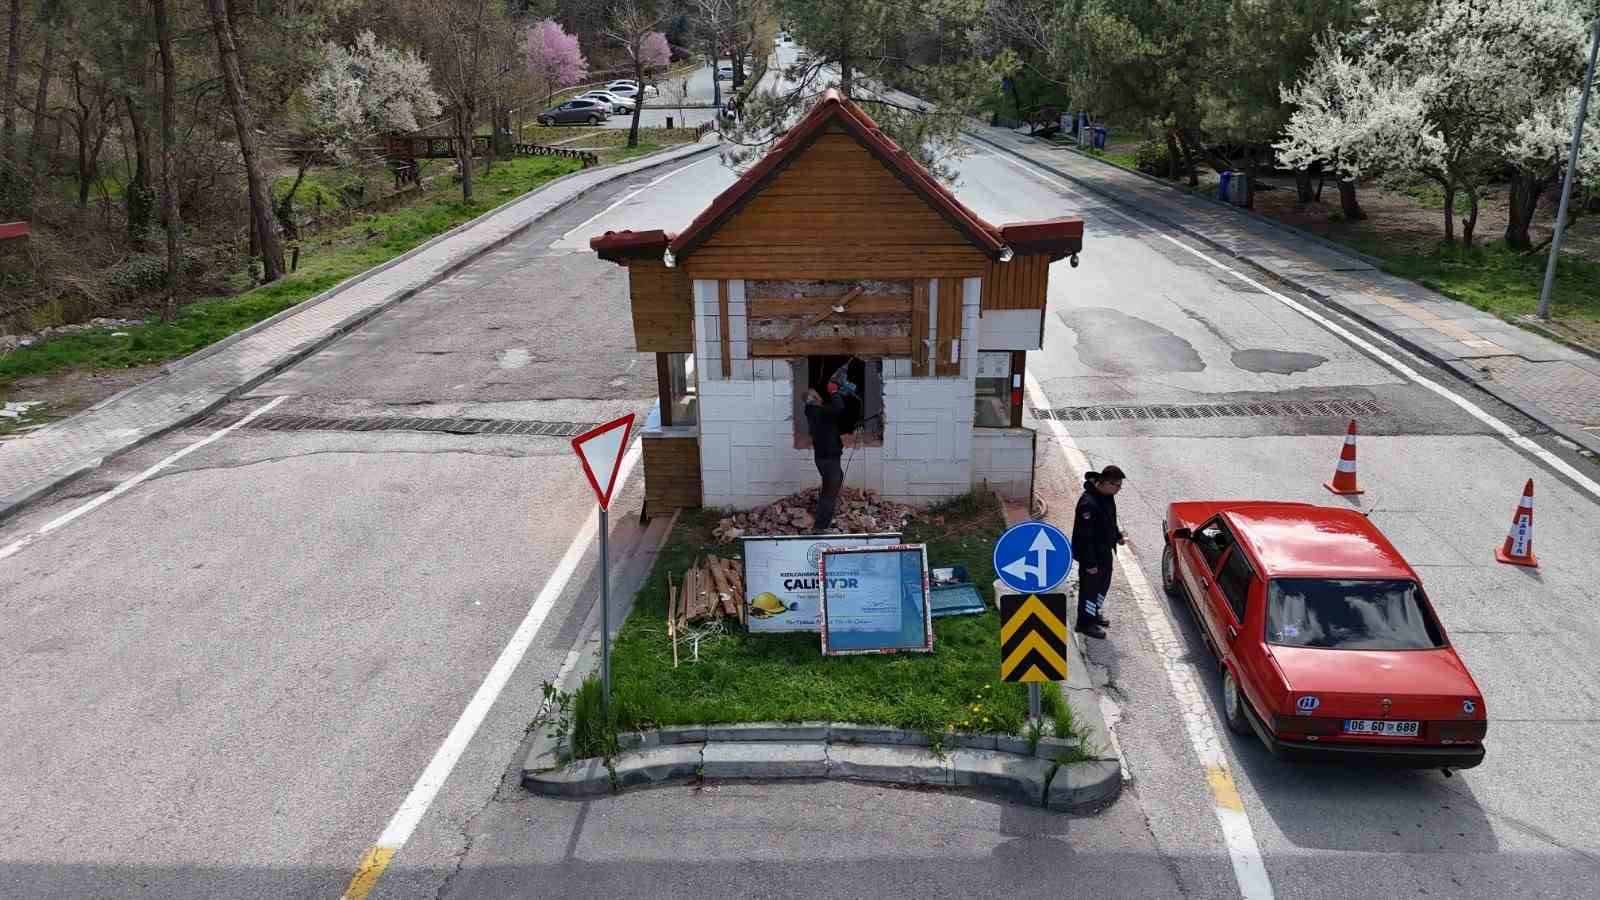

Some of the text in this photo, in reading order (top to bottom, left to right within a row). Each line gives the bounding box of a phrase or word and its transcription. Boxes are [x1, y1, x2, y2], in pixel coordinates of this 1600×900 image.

[1515, 516, 1529, 554] ZABITA
[1351, 720, 1365, 731] 06
[1396, 722, 1417, 733] 688
